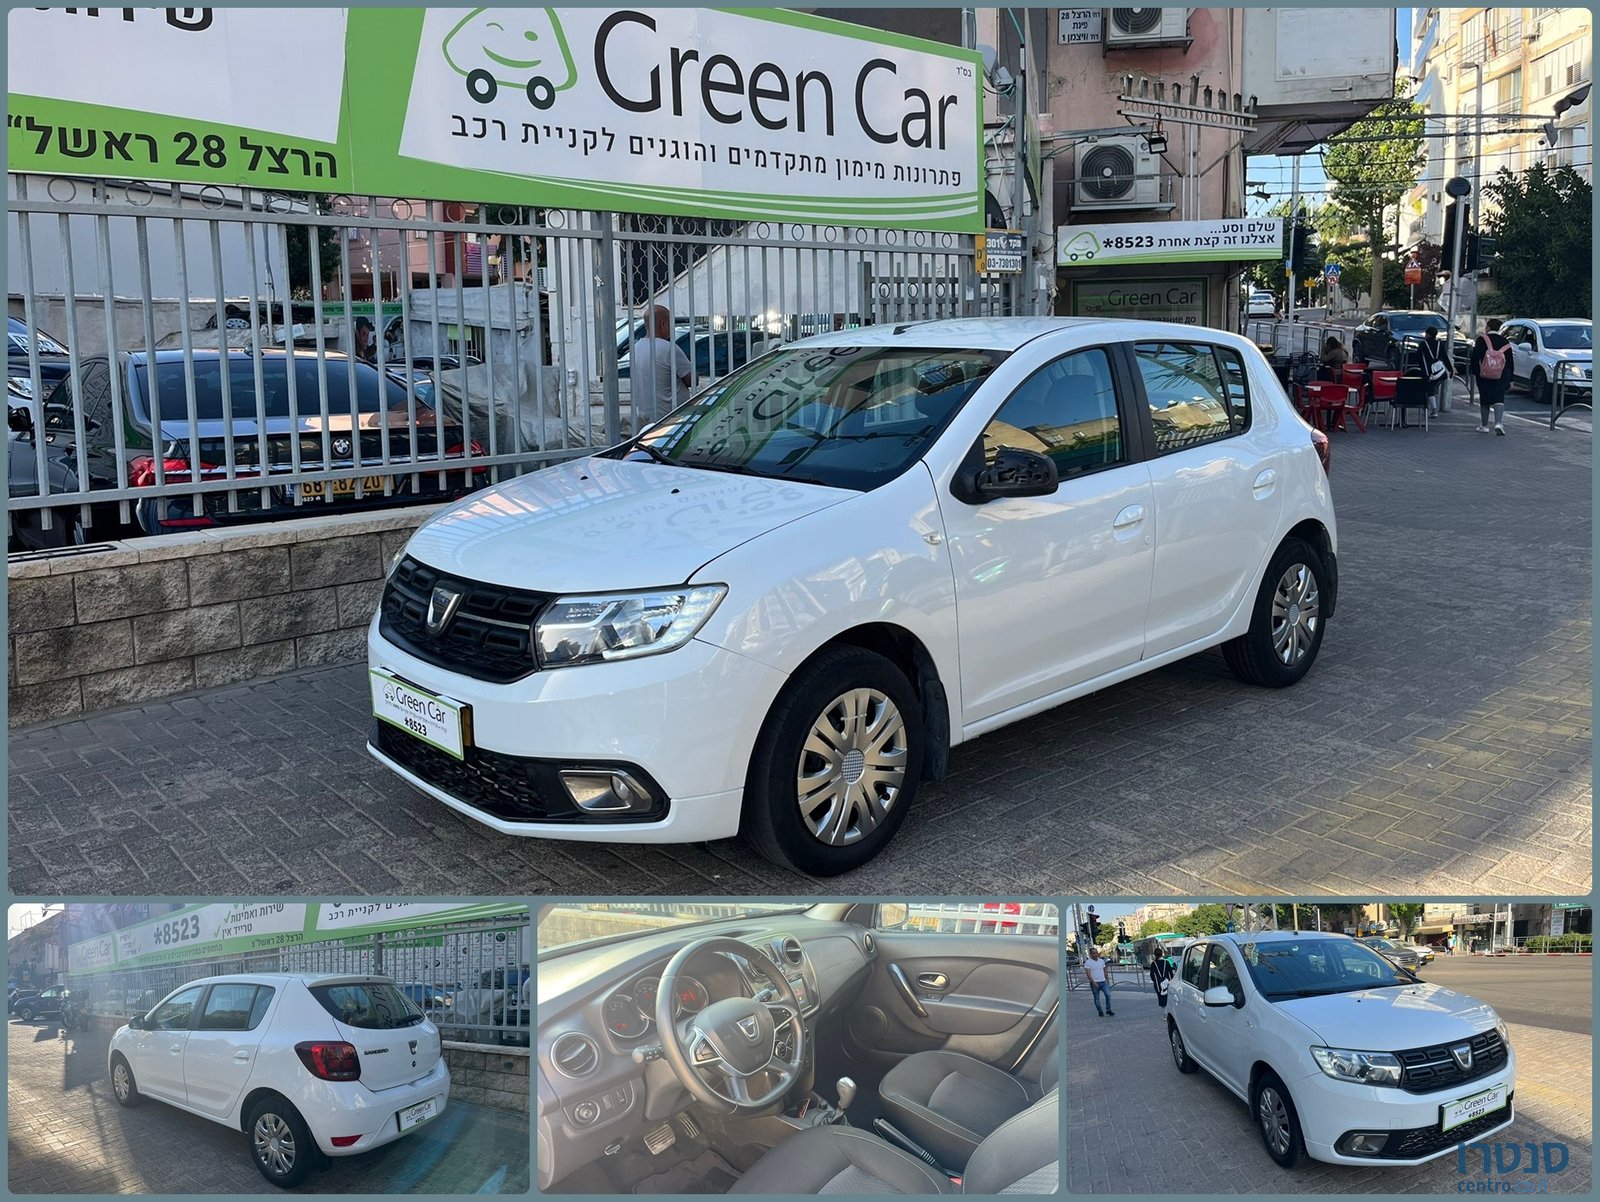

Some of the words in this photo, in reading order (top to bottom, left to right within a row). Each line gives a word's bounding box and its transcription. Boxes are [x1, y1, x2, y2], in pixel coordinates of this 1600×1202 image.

[1061, 12, 1070, 20] 28
[1071, 10, 1091, 19] הרצל
[1072, 21, 1088, 30] פינת
[593, 10, 835, 137] Green
[854, 58, 958, 151] Car
[451, 114, 507, 141] רכב
[521, 122, 616, 156] לקניית
[172, 131, 228, 169] 28
[629, 135, 717, 163] והוגנים
[239, 136, 338, 179] הרצל
[728, 146, 827, 176] מתקדמים
[835, 158, 886, 180] מימון
[893, 164, 961, 187] פתרונות
[1247, 222, 1276, 232] שלם
[986, 238, 1000, 248] 301
[1158, 237, 1191, 248] אחרת
[1194, 236, 1219, 248] קצת
[1223, 236, 1238, 245] זה
[1241, 234, 1275, 245] אצלנו
[1108, 289, 1161, 306] Green
[1166, 288, 1197, 305] Car
[1185, 316, 1197, 324] до
[396, 687, 426, 715] Green
[428, 701, 446, 723] Car
[259, 903, 284, 917] שירות
[329, 910, 344, 921] רכב
[347, 904, 380, 917] לקניית
[230, 910, 258, 924] ואמינות
[222, 927, 232, 939] אין
[233, 923, 253, 935] טרייד
[276, 935, 285, 944] 28
[285, 933, 304, 942] הרצל
[81, 944, 99, 961] Green
[100, 939, 112, 957] Car
[1464, 1096, 1486, 1110] Green
[1487, 1091, 1500, 1102] Car
[411, 1106, 424, 1116] Green
